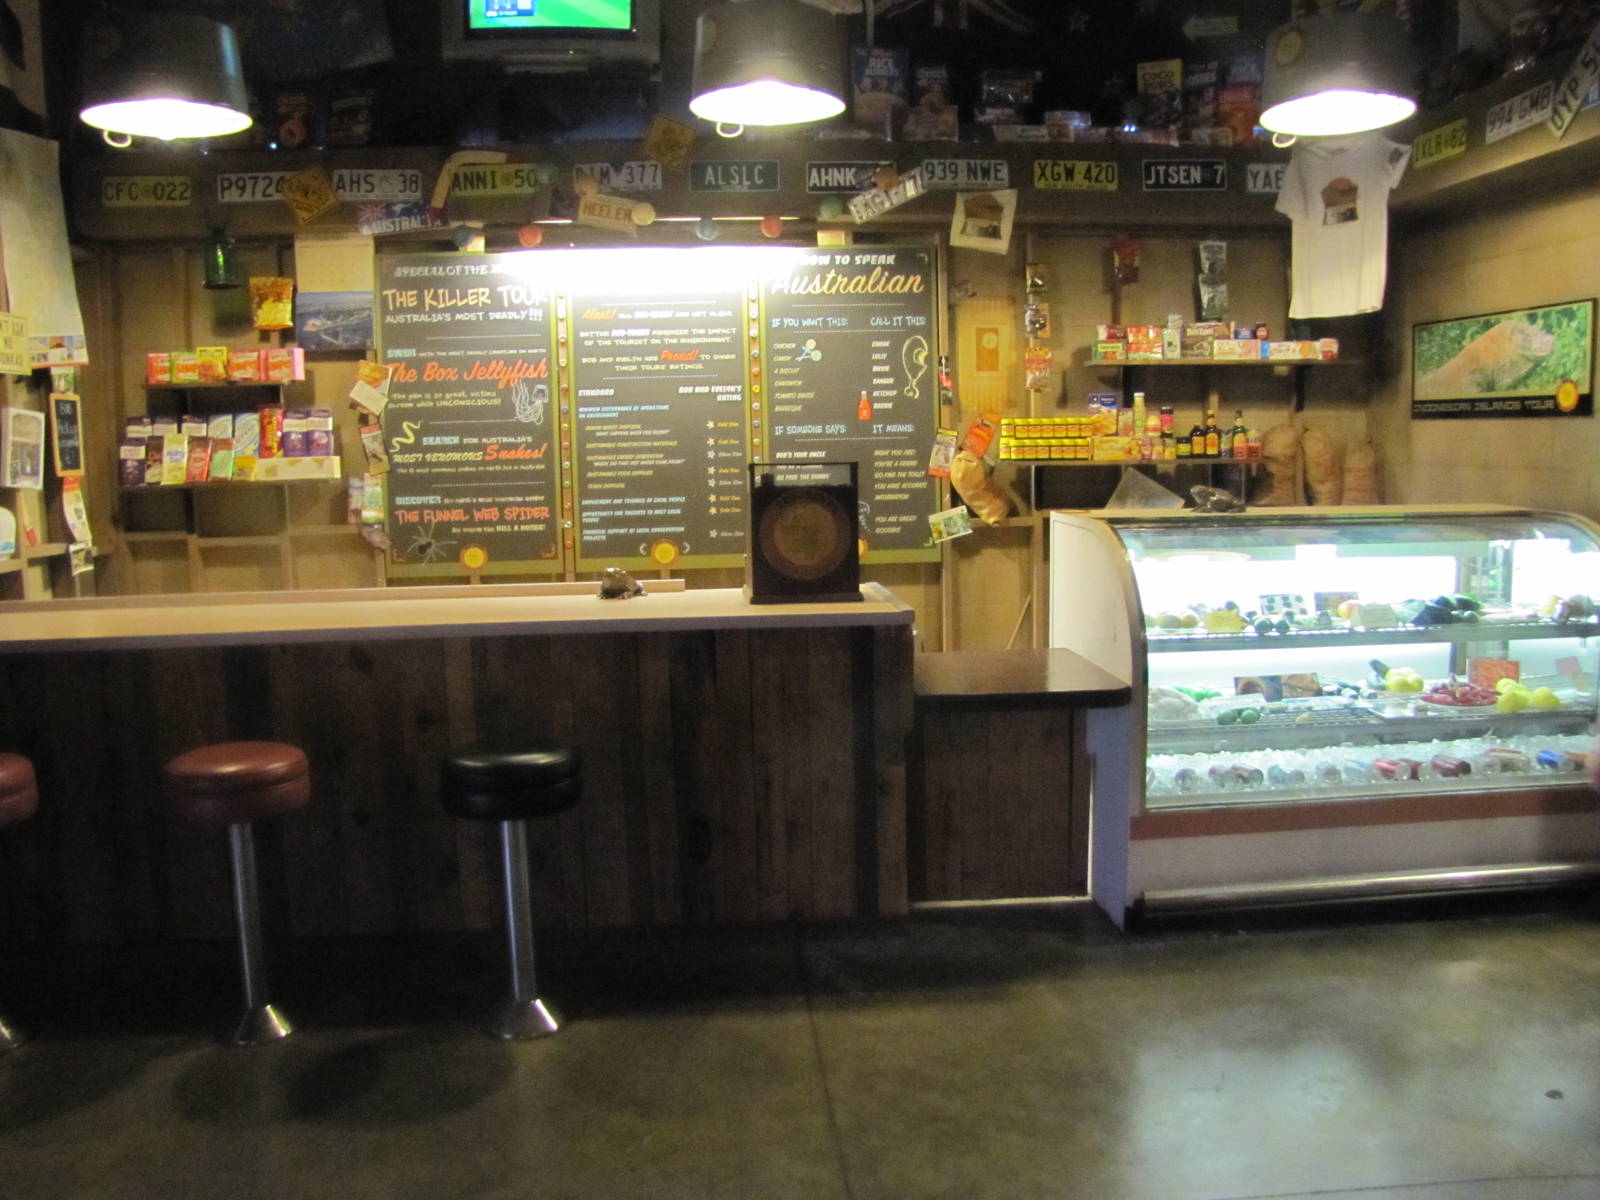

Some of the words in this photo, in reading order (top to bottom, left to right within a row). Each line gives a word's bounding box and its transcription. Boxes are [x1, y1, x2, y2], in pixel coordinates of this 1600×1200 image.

[626, 160, 660, 185] 377
[704, 165, 765, 185] ALSLC
[808, 167, 857, 187] AHNK
[924, 161, 959, 181] 939
[966, 161, 1005, 182] NWE
[1037, 163, 1076, 183] XGW
[1082, 164, 1116, 184] 420
[1146, 165, 1203, 184] JTSEN
[1213, 165, 1224, 184] 7
[335, 174, 376, 193] AHS
[398, 174, 420, 193] 38
[452, 171, 498, 192] ANNI
[104, 182, 139, 201] CFC
[153, 182, 190, 201] 022
[834, 255, 850, 265] TO
[854, 254, 896, 265] SPEAK
[446, 266, 463, 277] OF
[464, 264, 488, 276] THE
[769, 266, 924, 295] Australian
[383, 288, 418, 310] THE
[425, 287, 492, 311] KILLER
[498, 283, 548, 307] TOUR
[385, 312, 452, 324] AUSTRALIA'S
[455, 312, 485, 321] MOST
[772, 318, 781, 327] IF
[783, 317, 800, 328] YOU
[801, 317, 825, 327] WANT
[870, 316, 891, 326] CALL
[892, 316, 903, 326] IT
[384, 362, 418, 382] The
[423, 361, 459, 382] Box
[464, 357, 548, 388] Jellyfish
[775, 425, 784, 435] IF
[786, 424, 823, 434] SOMEONE
[872, 424, 883, 433] IT
[395, 509, 420, 524] THE
[423, 509, 470, 523] FUNNEL
[473, 507, 500, 521] WEB
[504, 506, 550, 520] SPIDER
